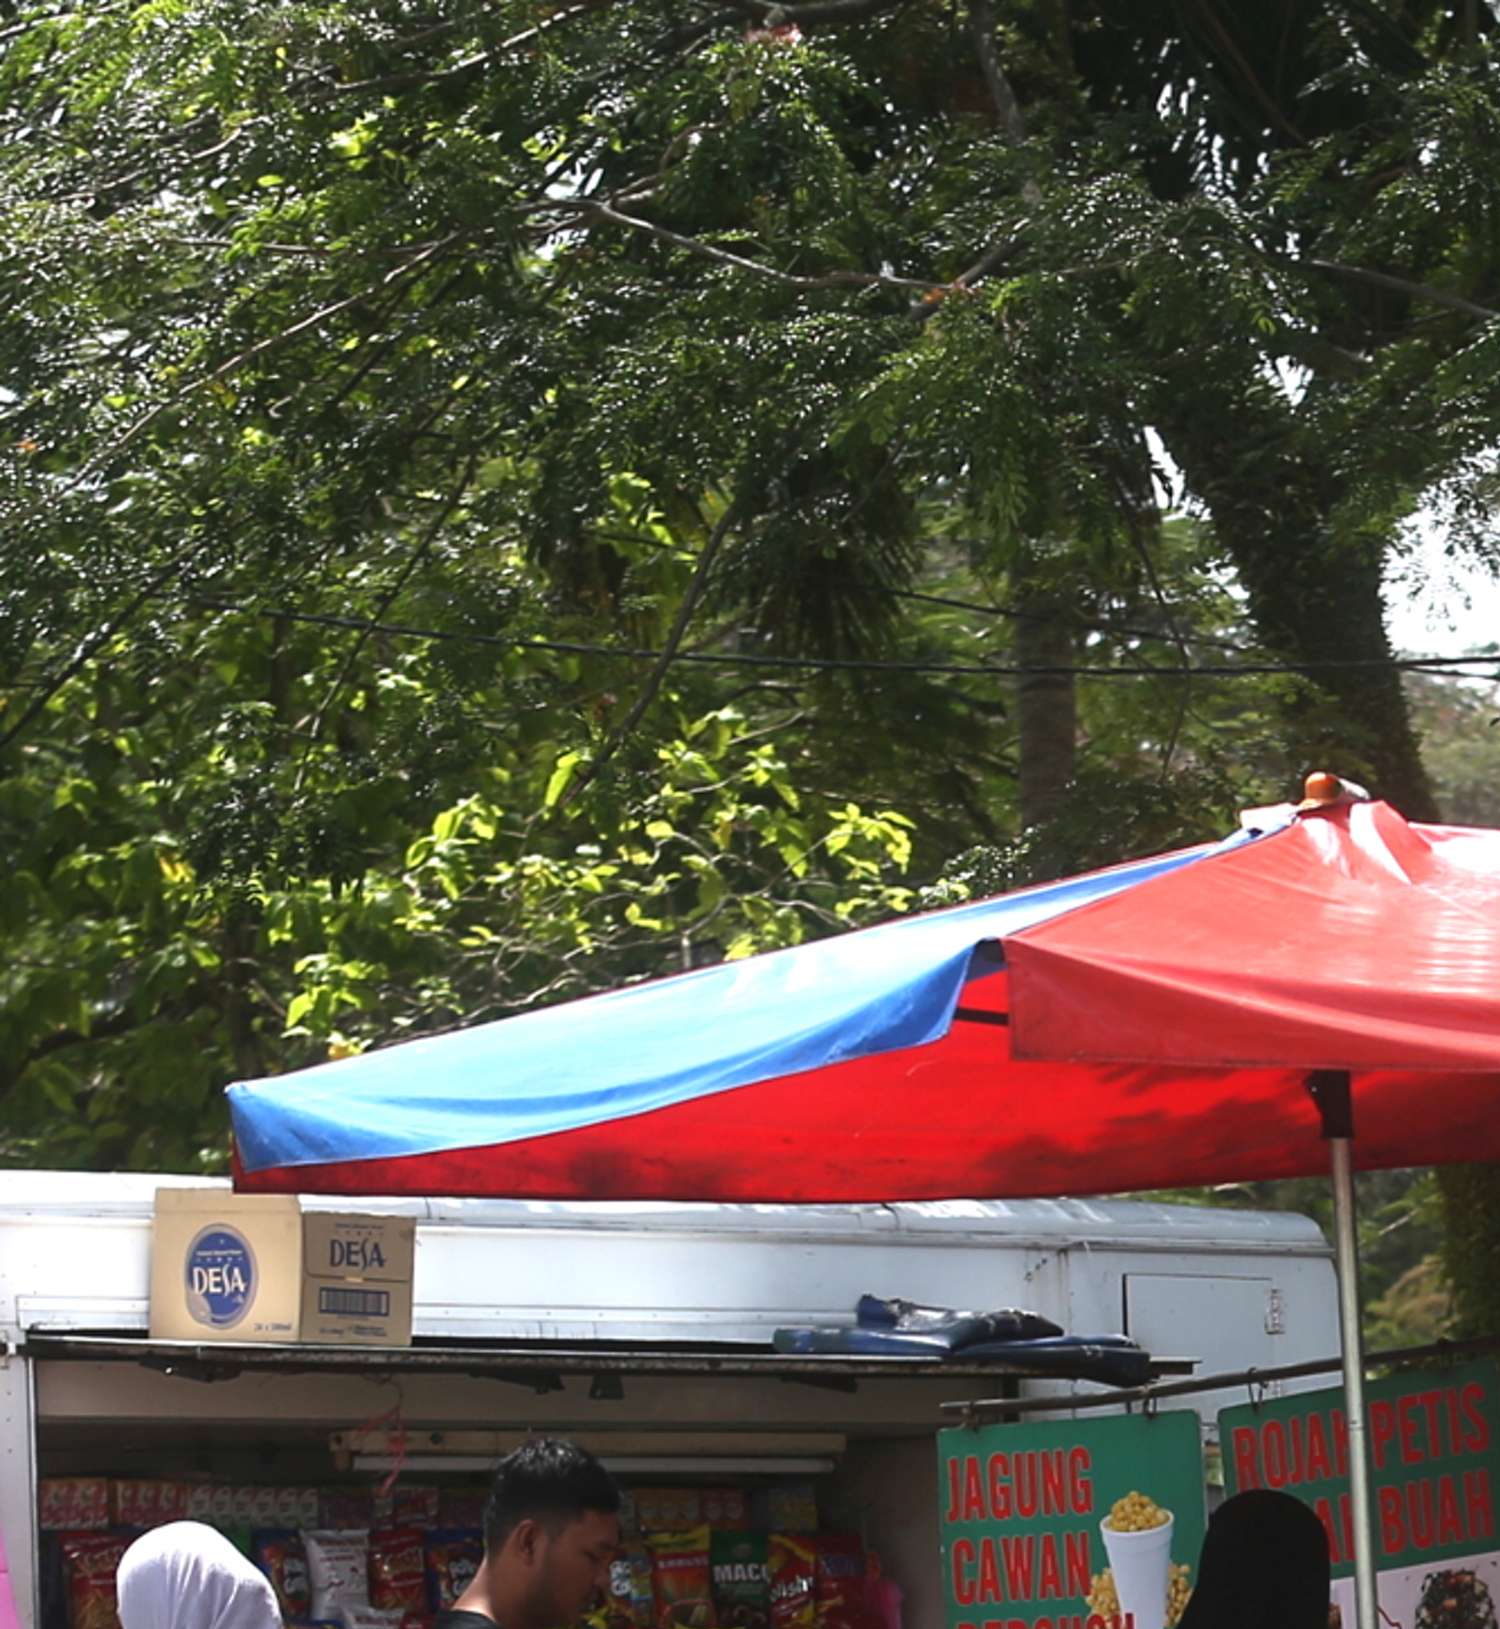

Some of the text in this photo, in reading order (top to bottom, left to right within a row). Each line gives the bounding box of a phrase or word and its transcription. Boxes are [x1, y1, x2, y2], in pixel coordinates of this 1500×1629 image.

[192, 1263, 247, 1298] DESA
[329, 1239, 386, 1271] DESA
[1368, 1381, 1491, 1470] PETIS
[946, 1445, 1093, 1523] JAGUNG
[1376, 1467, 1496, 1556] BUAH
[952, 1531, 1093, 1606] CAWAN
